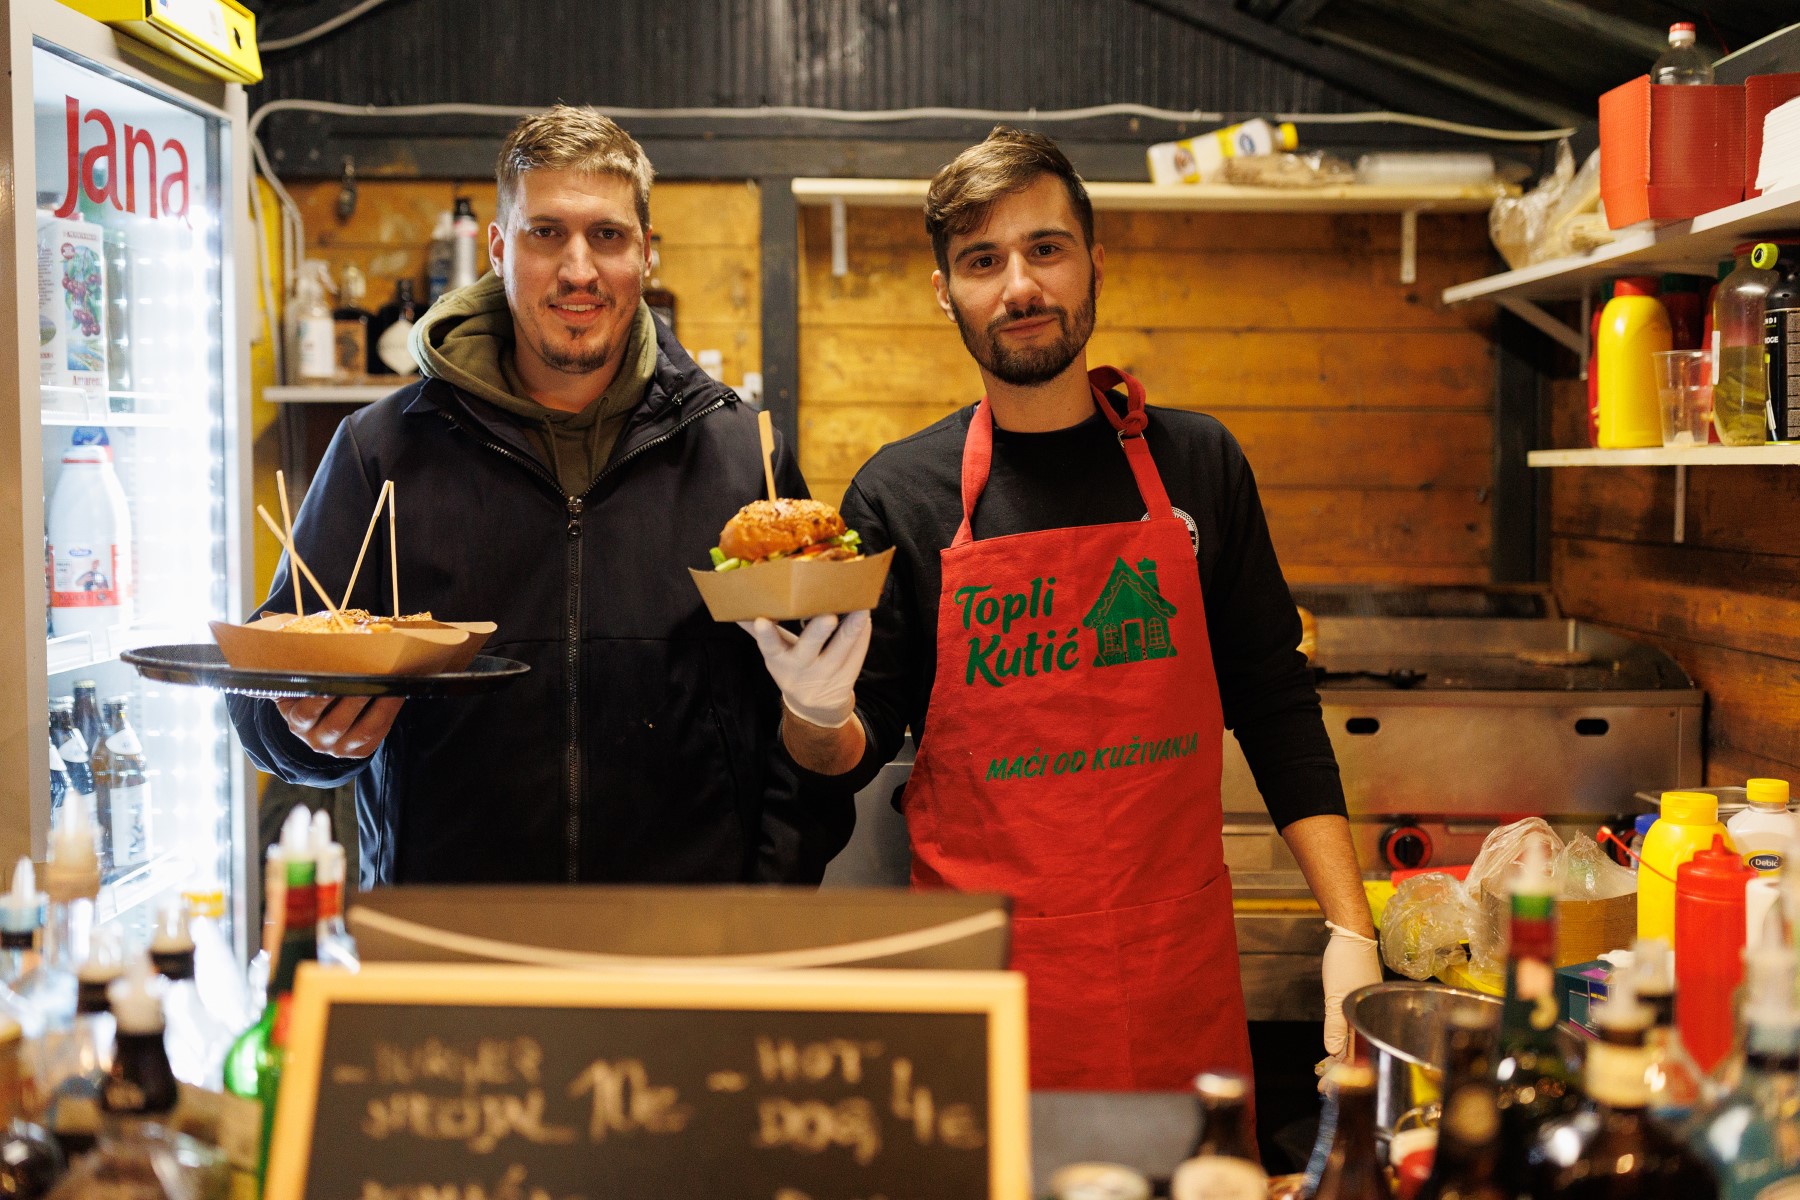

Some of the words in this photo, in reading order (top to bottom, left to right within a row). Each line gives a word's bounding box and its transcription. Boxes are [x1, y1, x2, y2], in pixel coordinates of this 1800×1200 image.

[54, 94, 193, 231] Jana
[954, 576, 1056, 634] Topli
[965, 626, 1079, 687] Kutić
[985, 747, 1048, 782] MAĆI
[1053, 750, 1087, 775] OD
[1091, 732, 1198, 771] KUŽIVANJA
[1755, 858, 1779, 867] Debic
